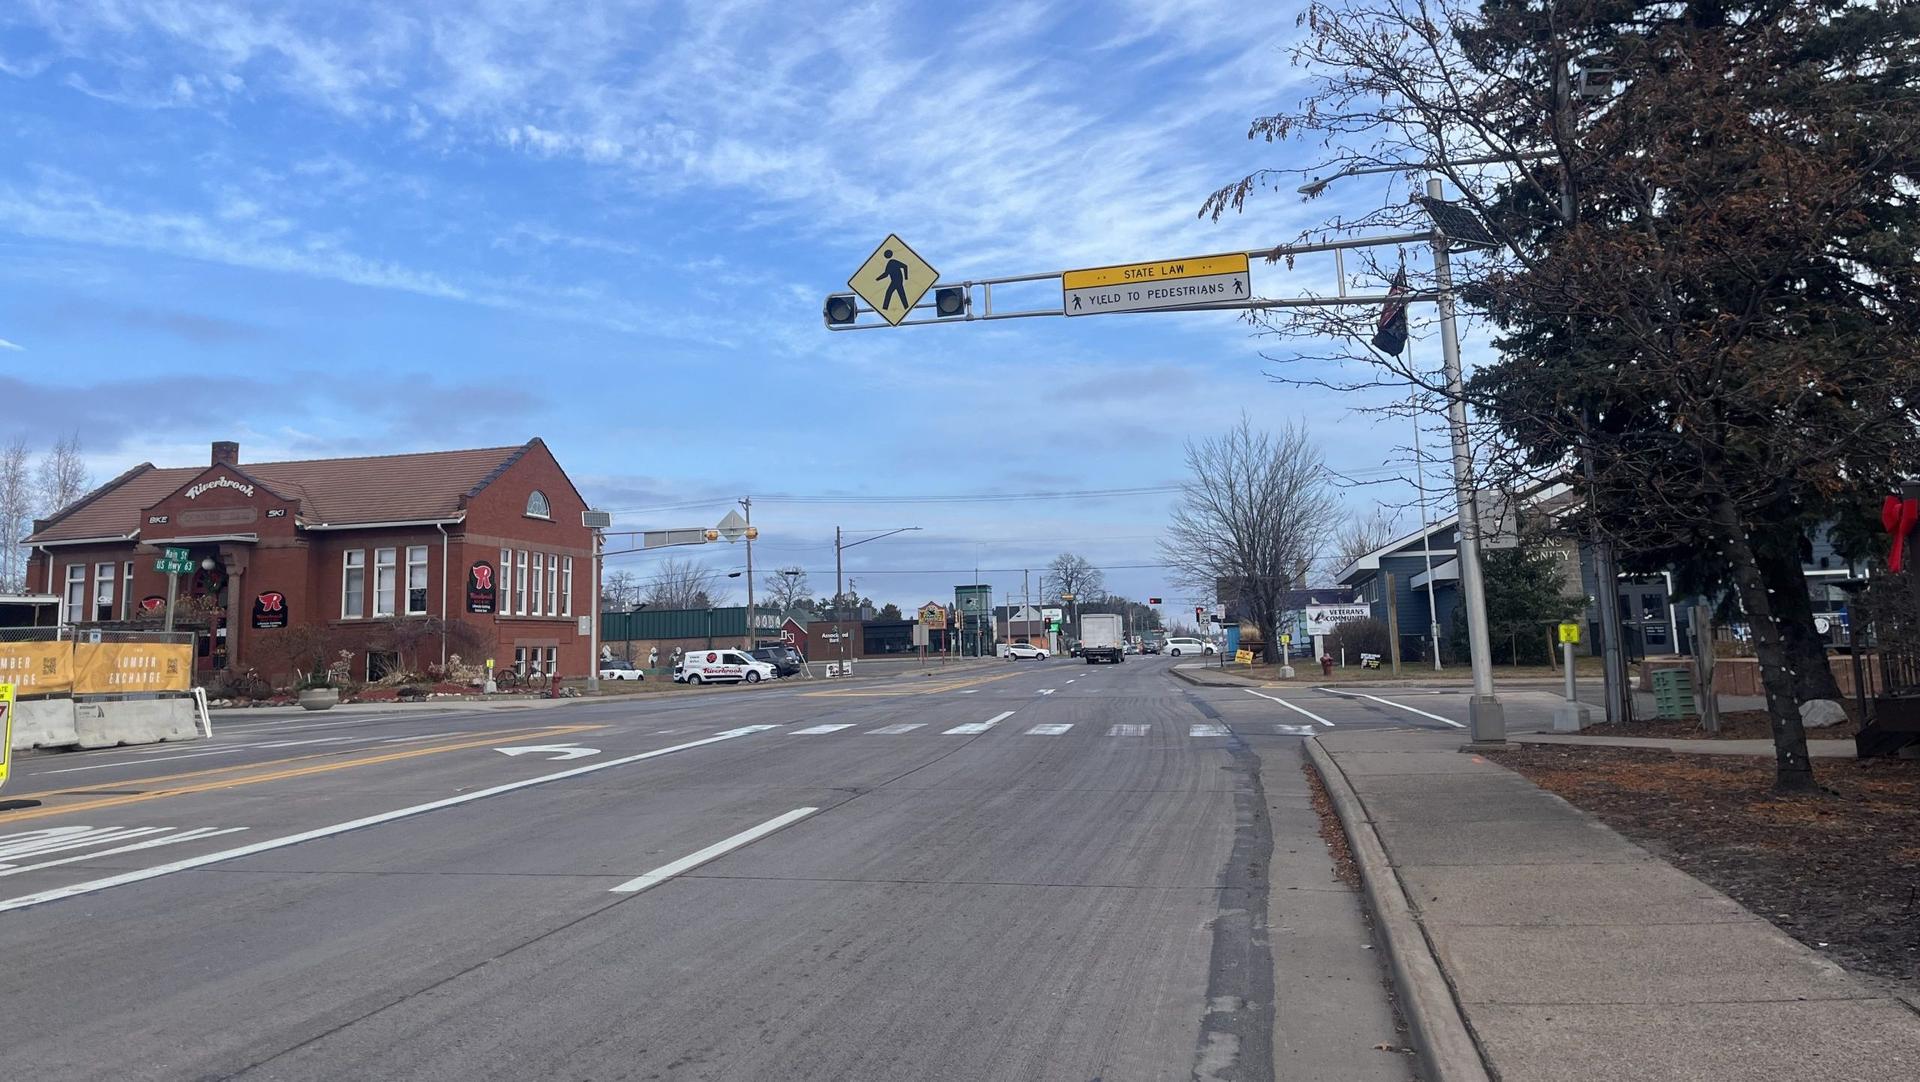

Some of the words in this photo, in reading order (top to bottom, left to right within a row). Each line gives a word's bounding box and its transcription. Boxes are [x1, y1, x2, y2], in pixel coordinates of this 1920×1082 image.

[1124, 267, 1155, 279] STATE
[1161, 264, 1185, 276] LAW
[1089, 293, 1121, 306] YIELD
[1127, 292, 1140, 302] TO
[1147, 283, 1225, 299] PEDESTRIANS
[184, 476, 255, 500] Riverbrook
[267, 509, 285, 518] SKI
[149, 516, 168, 524] BIKE
[165, 549, 178, 560] Main
[181, 550, 188, 560] St
[156, 561, 165, 570] US
[167, 562, 181, 571] Hwy
[184, 562, 193, 571] 63
